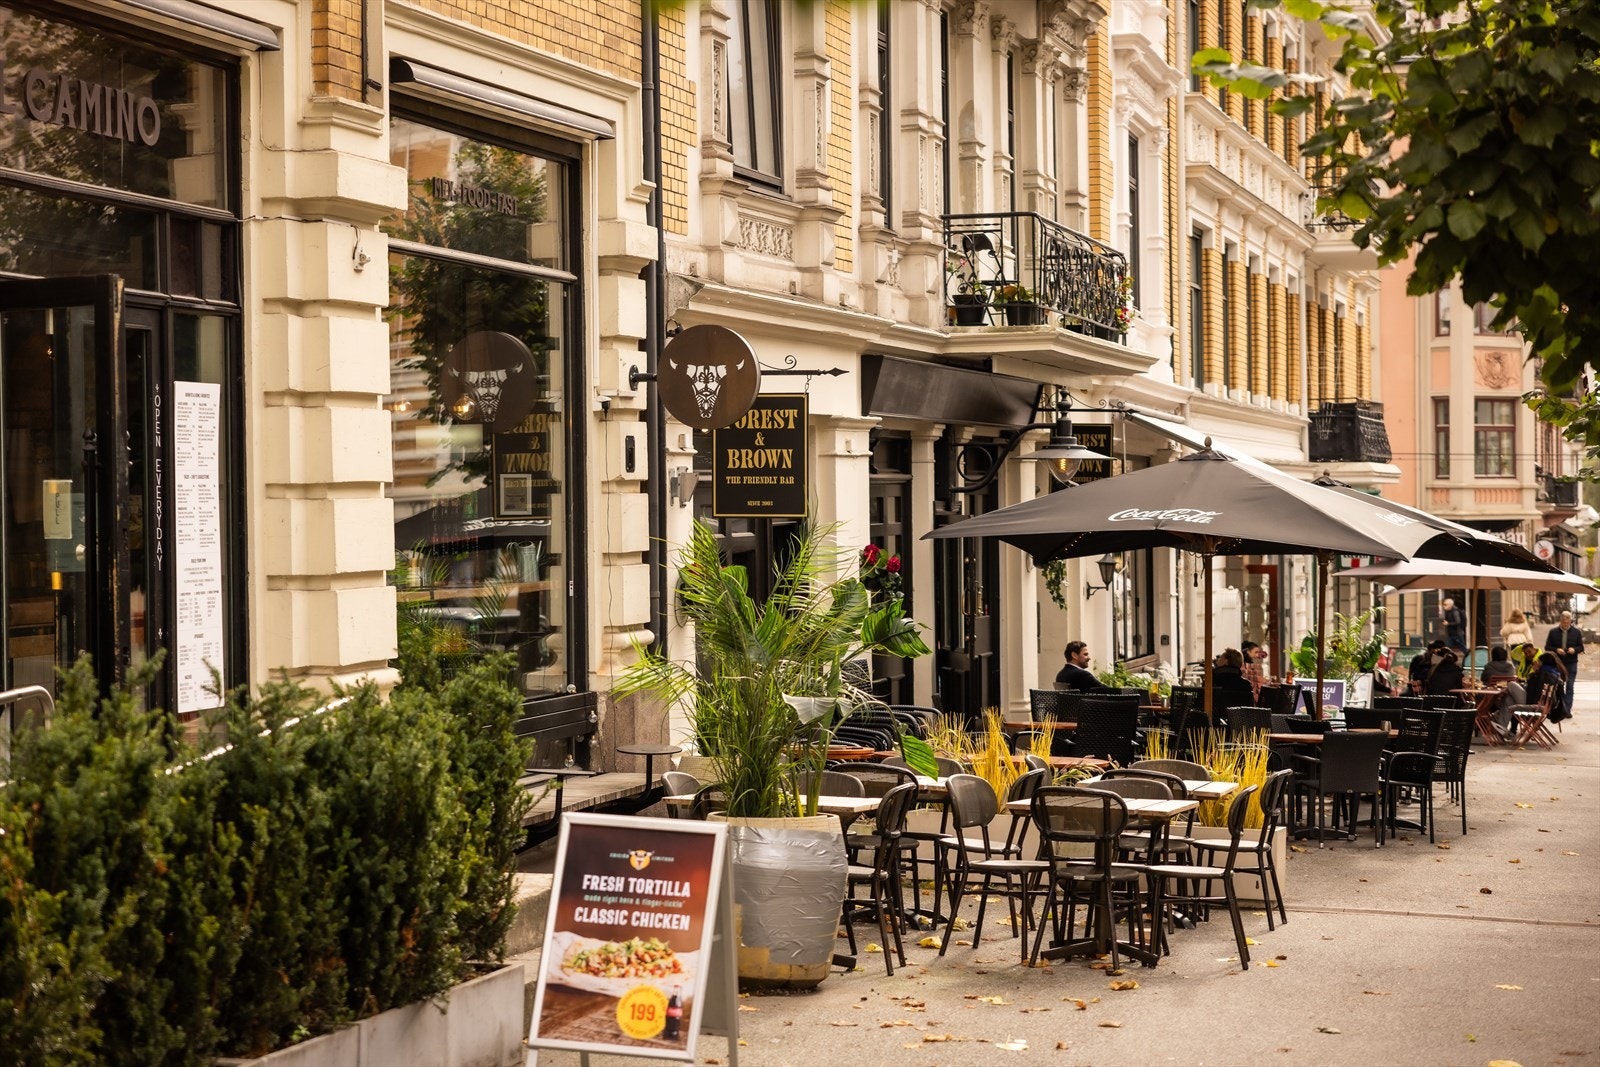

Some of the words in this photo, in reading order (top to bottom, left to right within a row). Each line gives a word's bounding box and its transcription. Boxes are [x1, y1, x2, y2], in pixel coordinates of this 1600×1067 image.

[0, 58, 16, 115] L
[23, 67, 161, 147] CAMINO
[154, 394, 162, 447] OPEN
[722, 408, 798, 430] OREST
[755, 432, 765, 446] &
[727, 448, 793, 469] BROWN
[725, 475, 742, 485] THE
[743, 475, 778, 485] FRIENDLY
[780, 475, 795, 485] BAR
[155, 458, 163, 571] EVERYDAY
[1108, 508, 1223, 524] Coca-Cola
[582, 874, 625, 893] FRESH
[628, 877, 691, 898] TORTILLA
[574, 906, 629, 926] CLASSIC
[630, 910, 691, 931] CHICKEN
